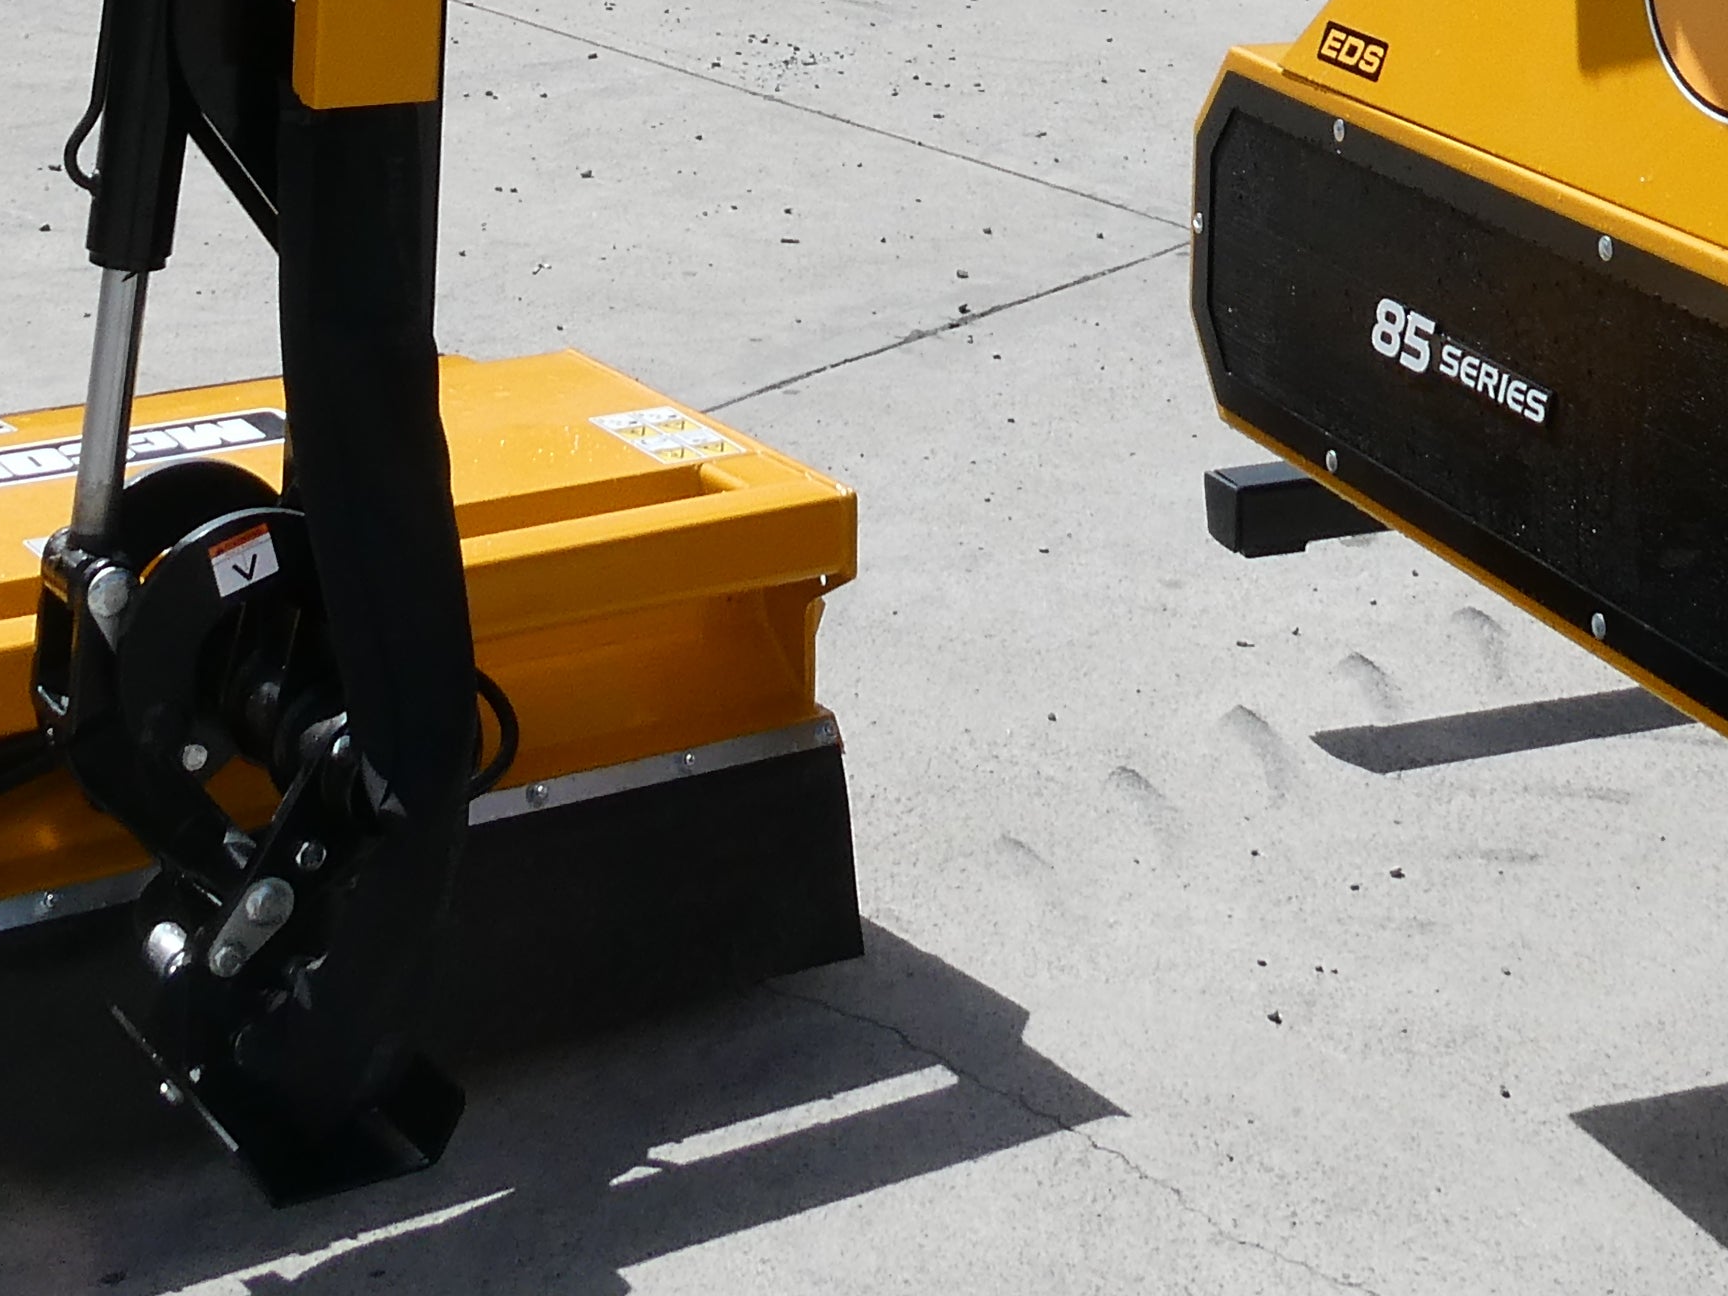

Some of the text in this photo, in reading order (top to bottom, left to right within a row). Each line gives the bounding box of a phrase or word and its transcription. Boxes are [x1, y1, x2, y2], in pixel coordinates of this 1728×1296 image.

[1320, 28, 1384, 76] EDS
[1370, 297, 1549, 425] 85 SERIES
